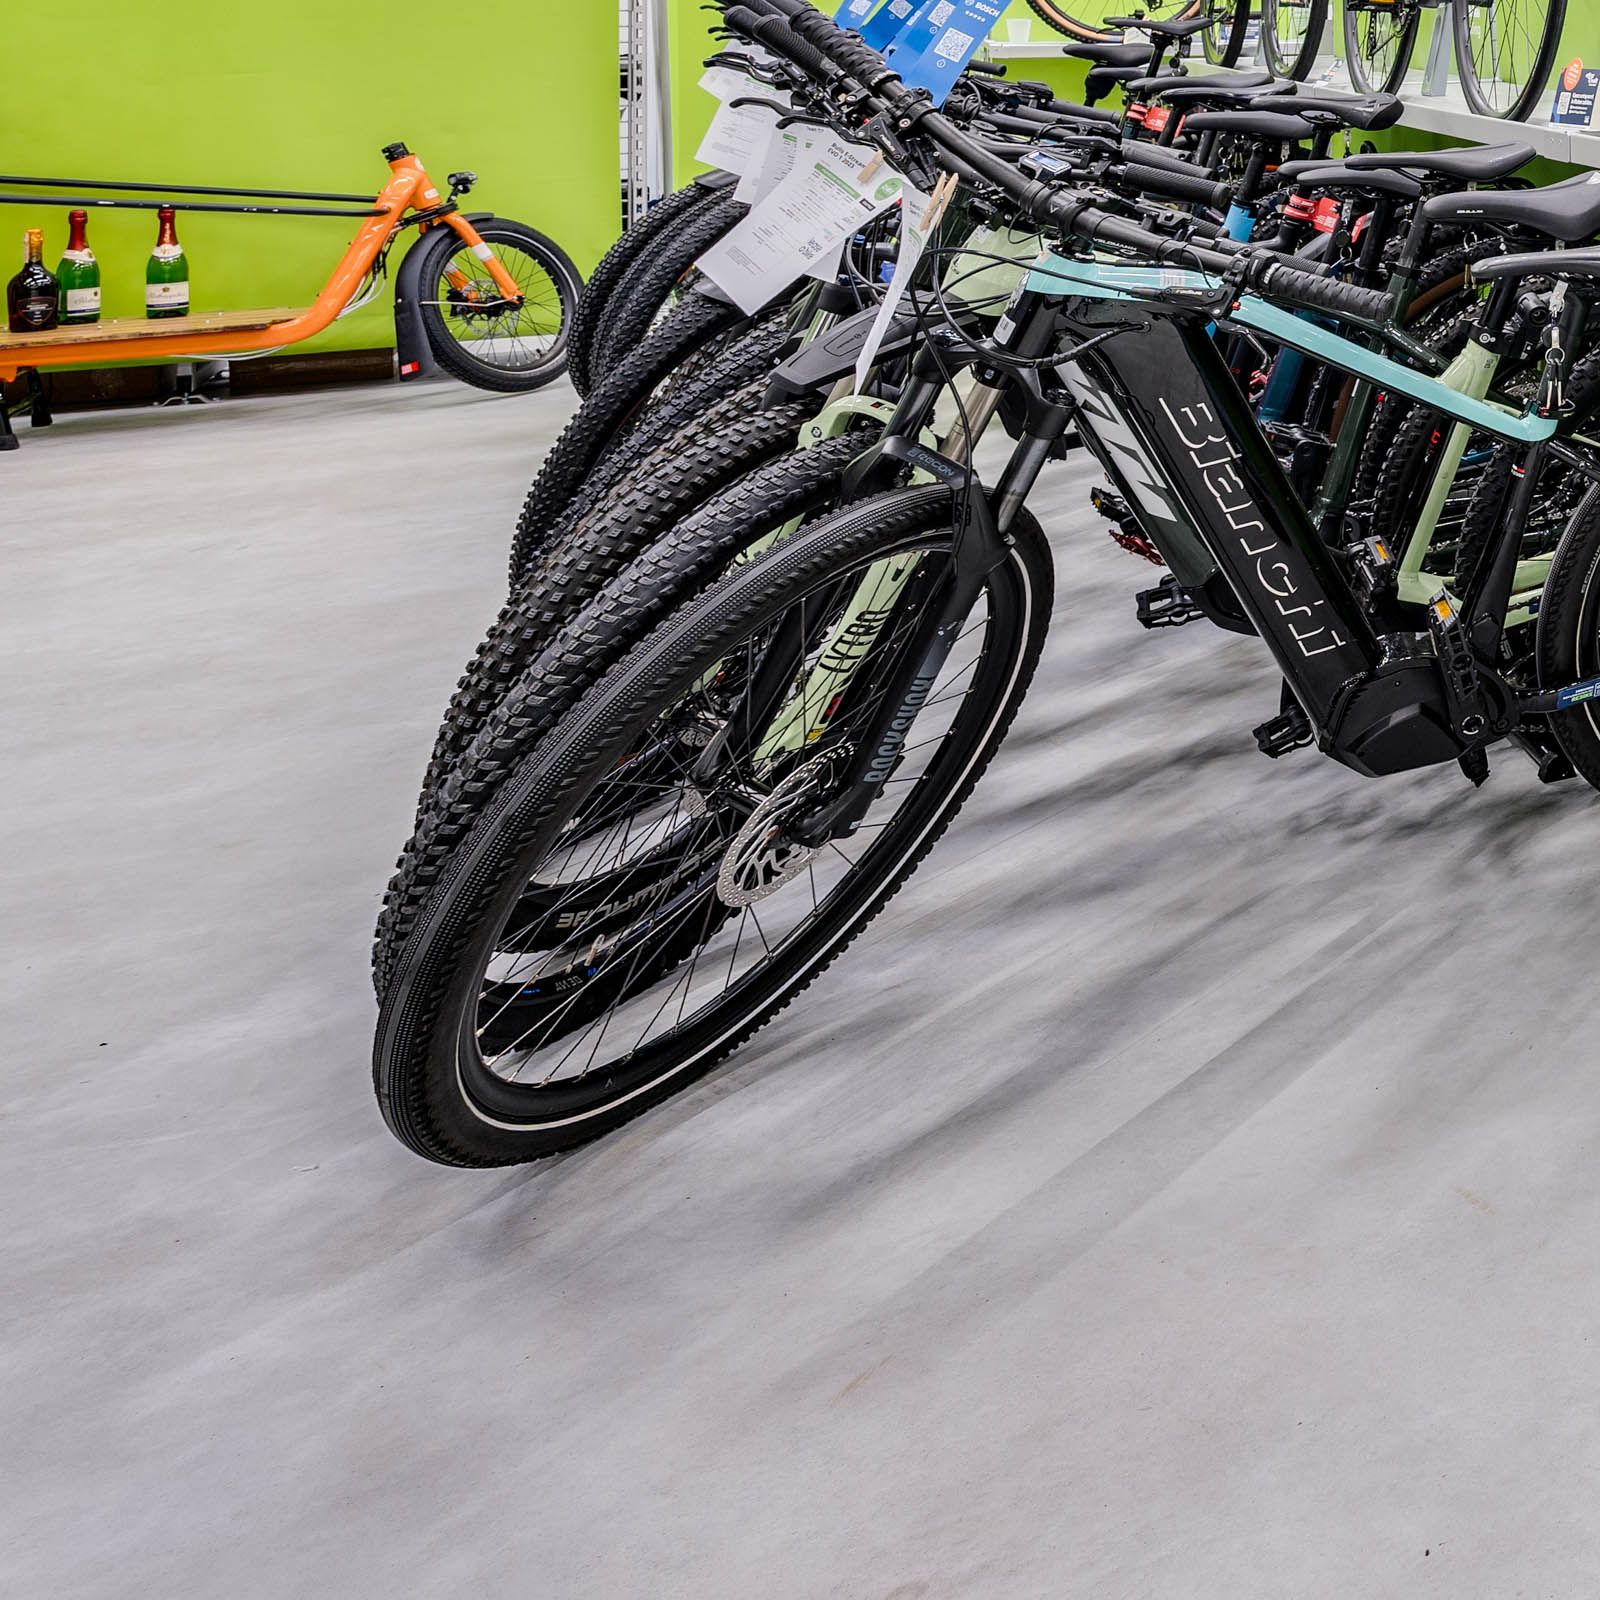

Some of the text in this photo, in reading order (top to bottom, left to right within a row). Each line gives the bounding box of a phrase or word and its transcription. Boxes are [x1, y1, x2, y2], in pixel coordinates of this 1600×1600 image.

[975, 1, 1001, 18] BOSCH
[917, 451, 955, 477] RECON
[1158, 396, 1347, 658] Bianchi
